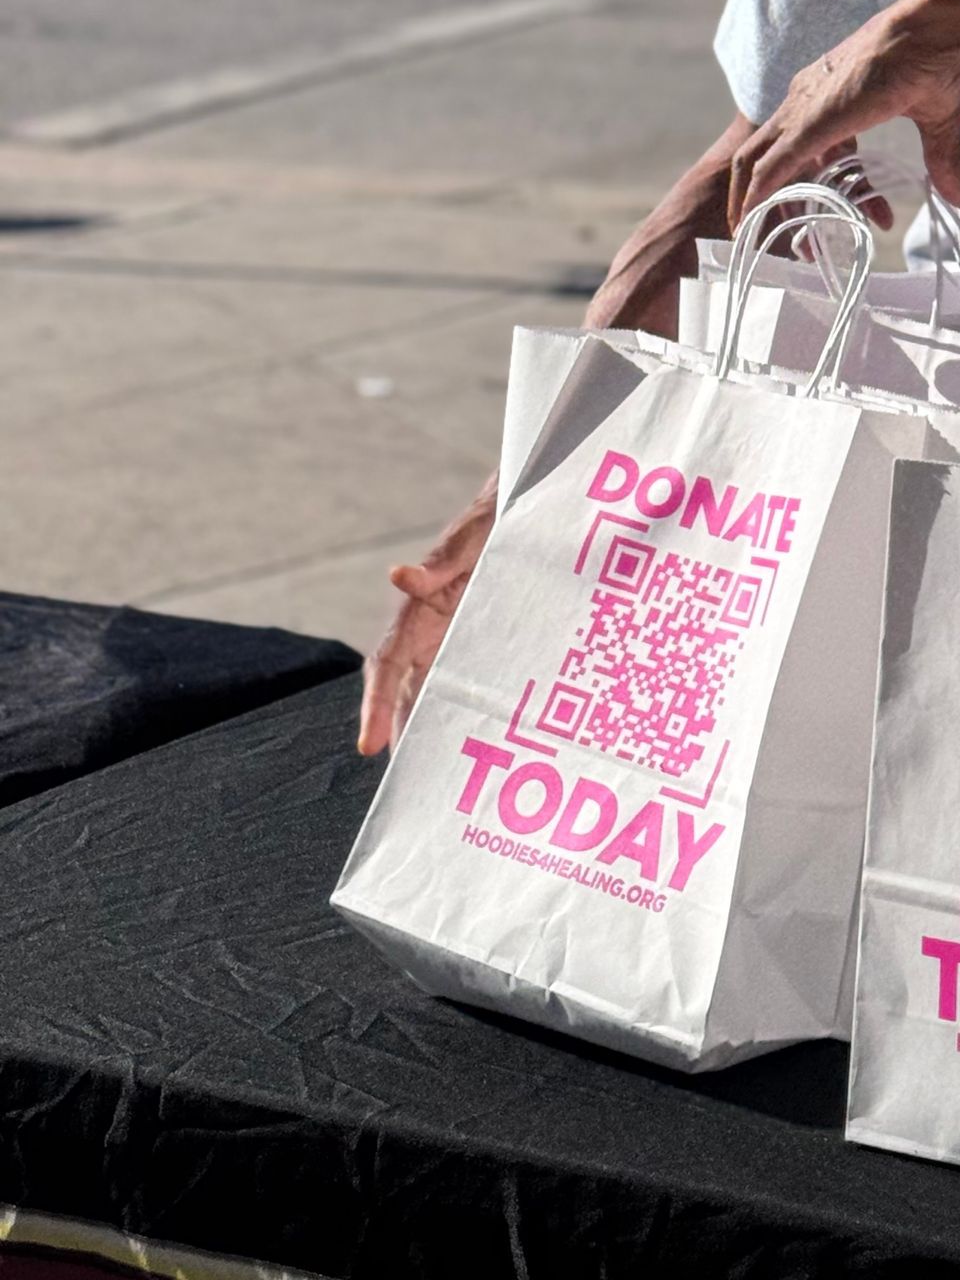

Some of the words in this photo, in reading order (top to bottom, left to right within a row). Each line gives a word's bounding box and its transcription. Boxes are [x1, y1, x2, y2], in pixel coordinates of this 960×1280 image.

[586, 449, 801, 553] DONATE
[456, 736, 726, 892] TODAY
[460, 824, 667, 913] HOODIES4HEALING.ORG
